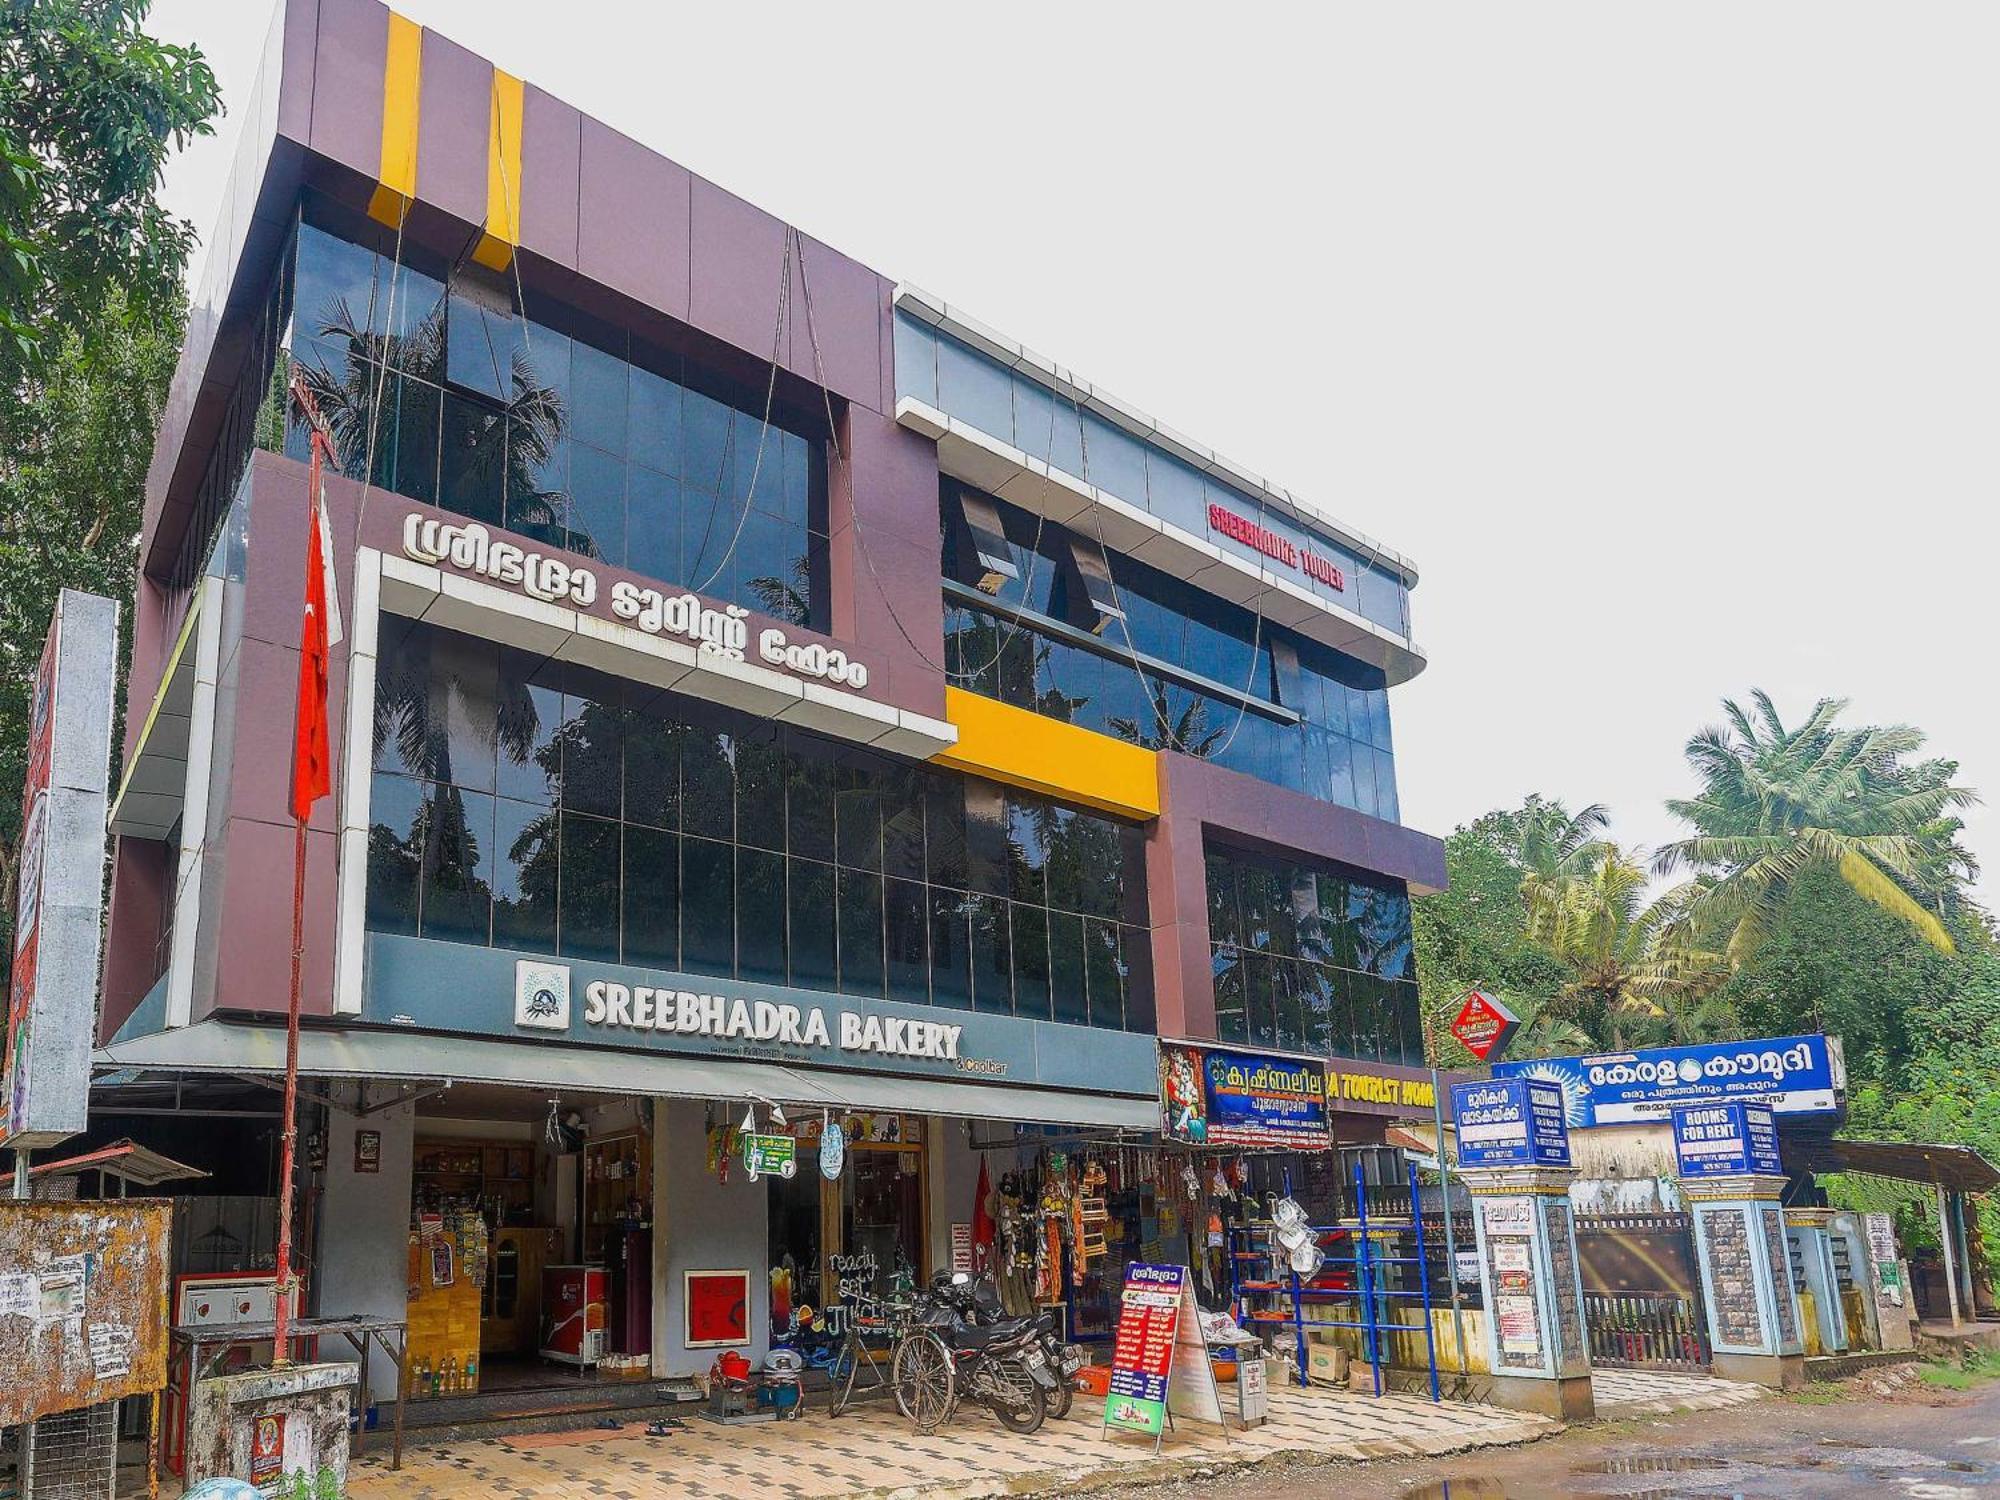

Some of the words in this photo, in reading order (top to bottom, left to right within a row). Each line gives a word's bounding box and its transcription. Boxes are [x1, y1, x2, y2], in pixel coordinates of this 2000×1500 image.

[1300, 550, 1345, 592] TOWER
[403, 512, 597, 607] ശ്രീഭദ്രാ
[611, 581, 750, 663] ടൂറിസ്റ്റ്
[759, 628, 869, 689] ഹോം
[584, 980, 832, 1049] SREEBHADRA
[840, 1010, 963, 1061] BAKERY
[964, 1057, 1008, 1076] Coolbar
[1227, 1063, 1322, 1095] കൃഷ്ണലീല
[1588, 1060, 1679, 1086] കേരള
[1341, 1074, 1400, 1104] TOURIST
[1682, 1126, 1706, 1140] FOR
[1706, 1123, 1736, 1138] RENT
[1685, 1109, 1729, 1126] ROOMS
